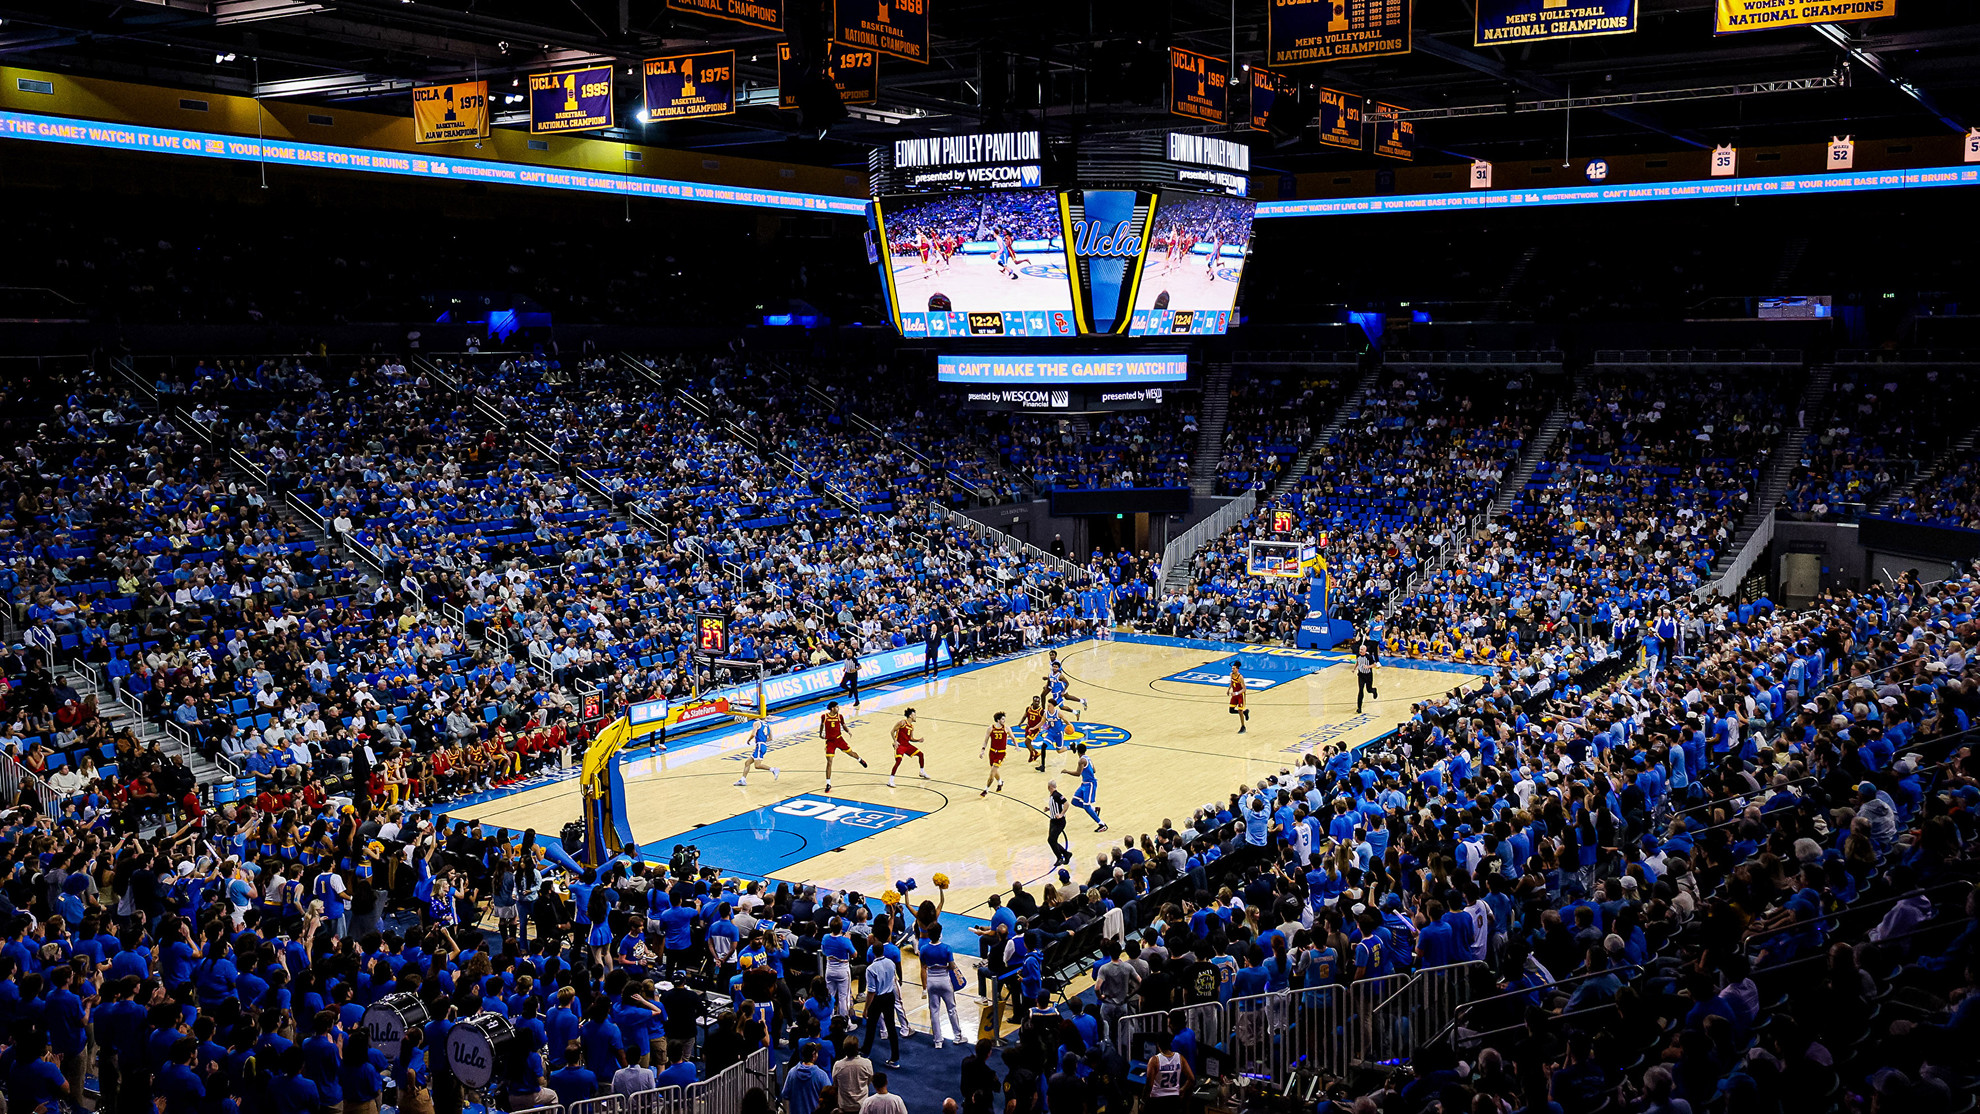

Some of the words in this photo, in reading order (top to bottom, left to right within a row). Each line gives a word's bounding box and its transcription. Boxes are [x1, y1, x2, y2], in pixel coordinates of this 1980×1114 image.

[728, 1, 777, 23] CHAMPIONS
[1506, 13, 1537, 24] MEN'S
[1539, 6, 1605, 21] VOLLEYBALL
[1729, 10, 1799, 26] NATIONAL
[1802, 1, 1884, 18] CHAMPIONS
[861, 20, 904, 38] BASKETBALL
[1484, 23, 1548, 40] NATIONAL
[1550, 16, 1628, 33] CHAMPIONS
[844, 27, 879, 48] NATIONAL
[880, 35, 920, 56] CHAMPIONS
[1295, 37, 1322, 47] MEN'S
[1324, 30, 1382, 43] VOLLEYBALL
[1276, 47, 1333, 62] NATIONAL
[1335, 38, 1402, 55] CHAMPIONS
[840, 52, 872, 69] 1973
[645, 60, 677, 76] UCLA
[681, 58, 696, 97] 1
[700, 66, 730, 83] 1975
[1173, 51, 1196, 72] UCLA
[1197, 58, 1206, 97] 1
[1207, 71, 1225, 88] 1969
[531, 75, 560, 90] UCLA
[563, 74, 579, 111] 1
[581, 82, 609, 98] 1995
[414, 89, 440, 102] UCLA
[444, 87, 456, 121] 1
[671, 96, 706, 105] BASKETBALL
[1187, 94, 1213, 107] BASKETBALL
[1321, 91, 1337, 106] UCLA
[555, 110, 588, 119] BASKETBALL
[651, 106, 686, 117] NATIONAL
[686, 103, 727, 114] CHAMPIONS
[1177, 101, 1199, 115] NATIONAL
[1346, 108, 1359, 122] 1971
[436, 122, 466, 130] BASKETBALL
[537, 118, 569, 131] NATIONAL
[569, 116, 607, 128] CHAMPIONS
[1400, 120, 1413, 135] 1972
[7, 119, 35, 134] THE
[38, 123, 87, 139] GAME?
[89, 128, 135, 144] WATCH
[138, 134, 150, 145] IT
[152, 135, 180, 149] LIVE
[181, 137, 201, 150] ON
[425, 131, 443, 139] AIAW
[444, 128, 477, 138] CHAMPIONS
[229, 142, 260, 156] YOUR
[262, 146, 296, 159] HOME
[297, 149, 325, 162] BASE
[327, 152, 348, 164] FOR
[350, 154, 370, 166] THE
[372, 157, 409, 170] BRUINS
[895, 138, 928, 168] EDWIN
[929, 138, 940, 166] W
[942, 134, 983, 164] PAULEY
[984, 131, 1041, 162] PAVILION
[1170, 132, 1195, 163] EDWIN
[1204, 137, 1226, 167] PAULEY
[1833, 150, 1847, 160] 52
[1717, 157, 1730, 166] 35
[452, 165, 516, 179] @BIGTENNETWORK
[915, 170, 953, 185] presented
[954, 168, 965, 182] by
[967, 166, 1021, 182] WESCOM
[1180, 170, 1209, 181] presented
[1476, 170, 1486, 179] 31
[1586, 162, 1607, 179] 42
[520, 170, 545, 182] CAN'T
[546, 173, 570, 185] MAKE
[570, 176, 587, 187] THE
[588, 178, 614, 190] GAME?
[616, 181, 642, 191] WATCH
[651, 184, 668, 194] LIVE
[668, 186, 680, 195] ON
[991, 180, 1021, 189] Financial
[1798, 180, 1823, 189] YOUR
[1824, 178, 1852, 187] HOME
[1854, 177, 1878, 186] BASE
[1879, 176, 1898, 184] FOR
[1900, 175, 1919, 183] THE
[1921, 173, 1958, 182] BRUINS
[695, 188, 714, 198] YOUR
[715, 190, 734, 200] HOME
[736, 191, 752, 201] BASE
[753, 193, 765, 203] FOR
[766, 194, 779, 204] THE
[780, 196, 803, 206] BRUINS
[1603, 190, 1627, 198] CAN'T
[1629, 189, 1652, 197] MAKE
[1653, 188, 1669, 196] THE
[1671, 186, 1700, 195] GAME?
[1702, 184, 1735, 193] WATCH
[1743, 183, 1762, 191] LIVE
[1764, 182, 1777, 190] ON
[1427, 198, 1446, 206] BASE
[1480, 195, 1507, 204] BRUINS
[1284, 205, 1308, 213] GAME?
[1074, 220, 1143, 257] Ucla
[958, 313, 965, 321] 3
[970, 316, 1001, 327] 12:24
[1005, 312, 1012, 321] 2
[1029, 318, 1044, 330] 13
[1150, 317, 1159, 328] 12
[1174, 315, 1192, 325] 12:24
[902, 318, 926, 332] Ucla
[931, 319, 944, 331] 12
[958, 328, 965, 336] 4
[1009, 328, 1016, 336] 4
[958, 363, 992, 376] CAN'T
[993, 363, 1034, 377] MAKE
[1037, 364, 1068, 377] THE
[1071, 363, 1124, 377] GAME?
[1126, 362, 1166, 375] WATCH
[1166, 362, 1174, 374] IT
[968, 393, 991, 402] presented
[992, 393, 1000, 403] by
[1002, 391, 1049, 402] WESCOM
[1102, 392, 1137, 403] presented
[1137, 391, 1145, 402] by
[1275, 518, 1291, 532] 27
[702, 618, 723, 630] 12:24
[702, 629, 722, 649] 27
[765, 677, 803, 700] MISS
[803, 669, 833, 692] THE
[585, 704, 599, 718] 27
[1302, 833, 1310, 847] 3
[984, 1011, 994, 1031] 3
[368, 1022, 400, 1042] Ucla
[453, 1041, 486, 1069] Ucla
[1161, 1073, 1177, 1088] 24
